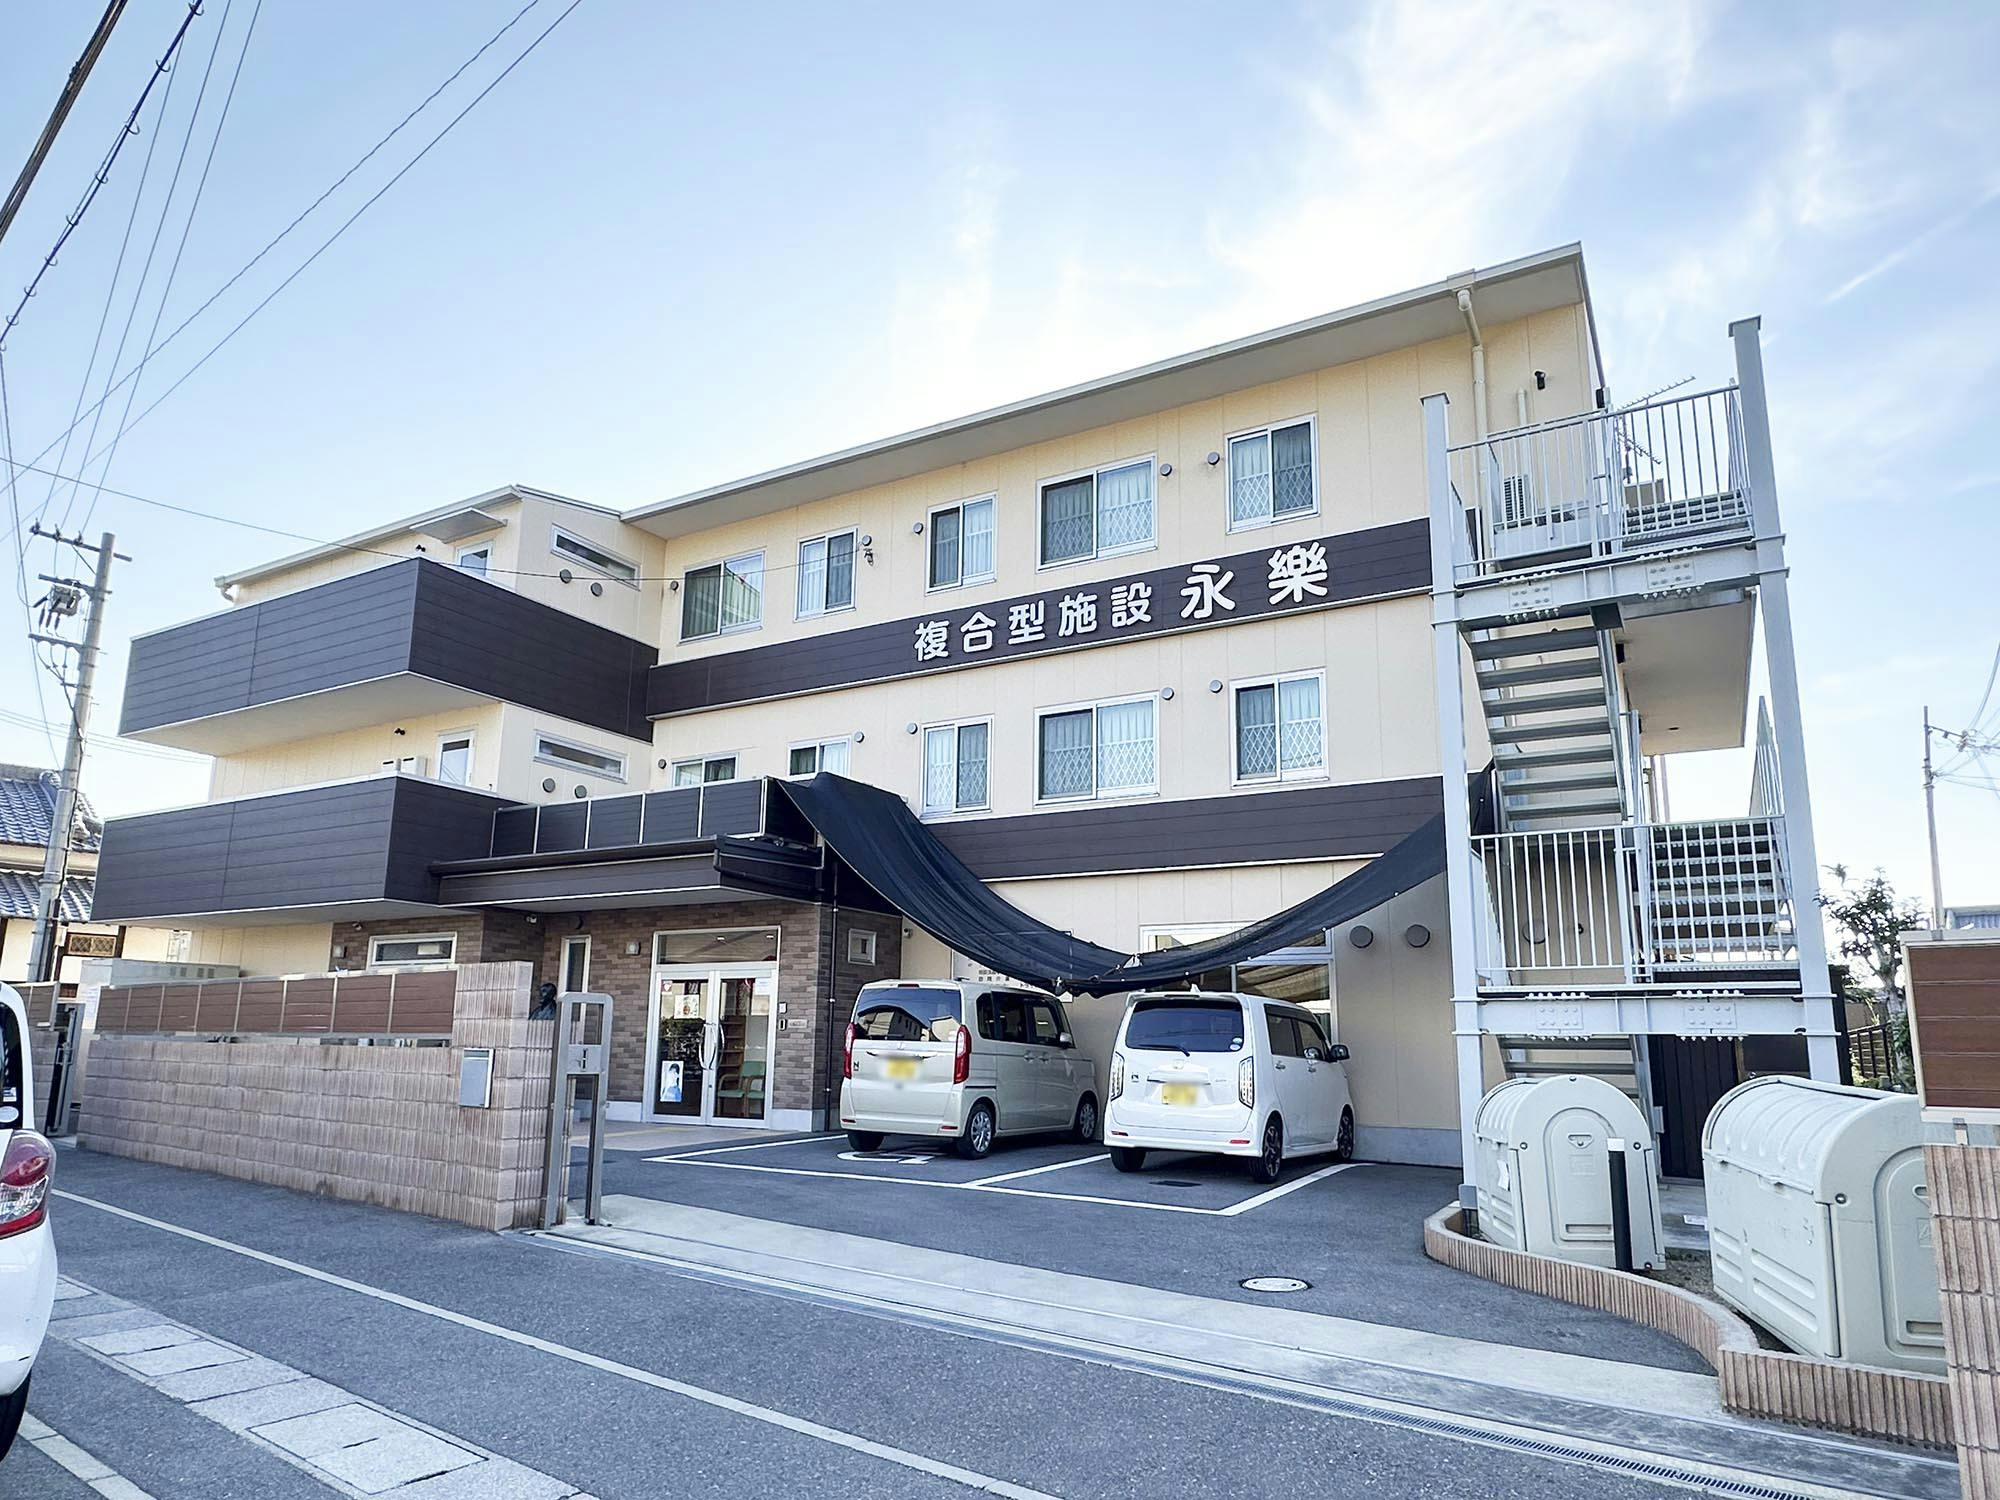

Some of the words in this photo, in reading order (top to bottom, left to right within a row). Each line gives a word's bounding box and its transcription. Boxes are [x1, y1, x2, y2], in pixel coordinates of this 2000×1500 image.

[914, 582, 1152, 662] 複合型施設
